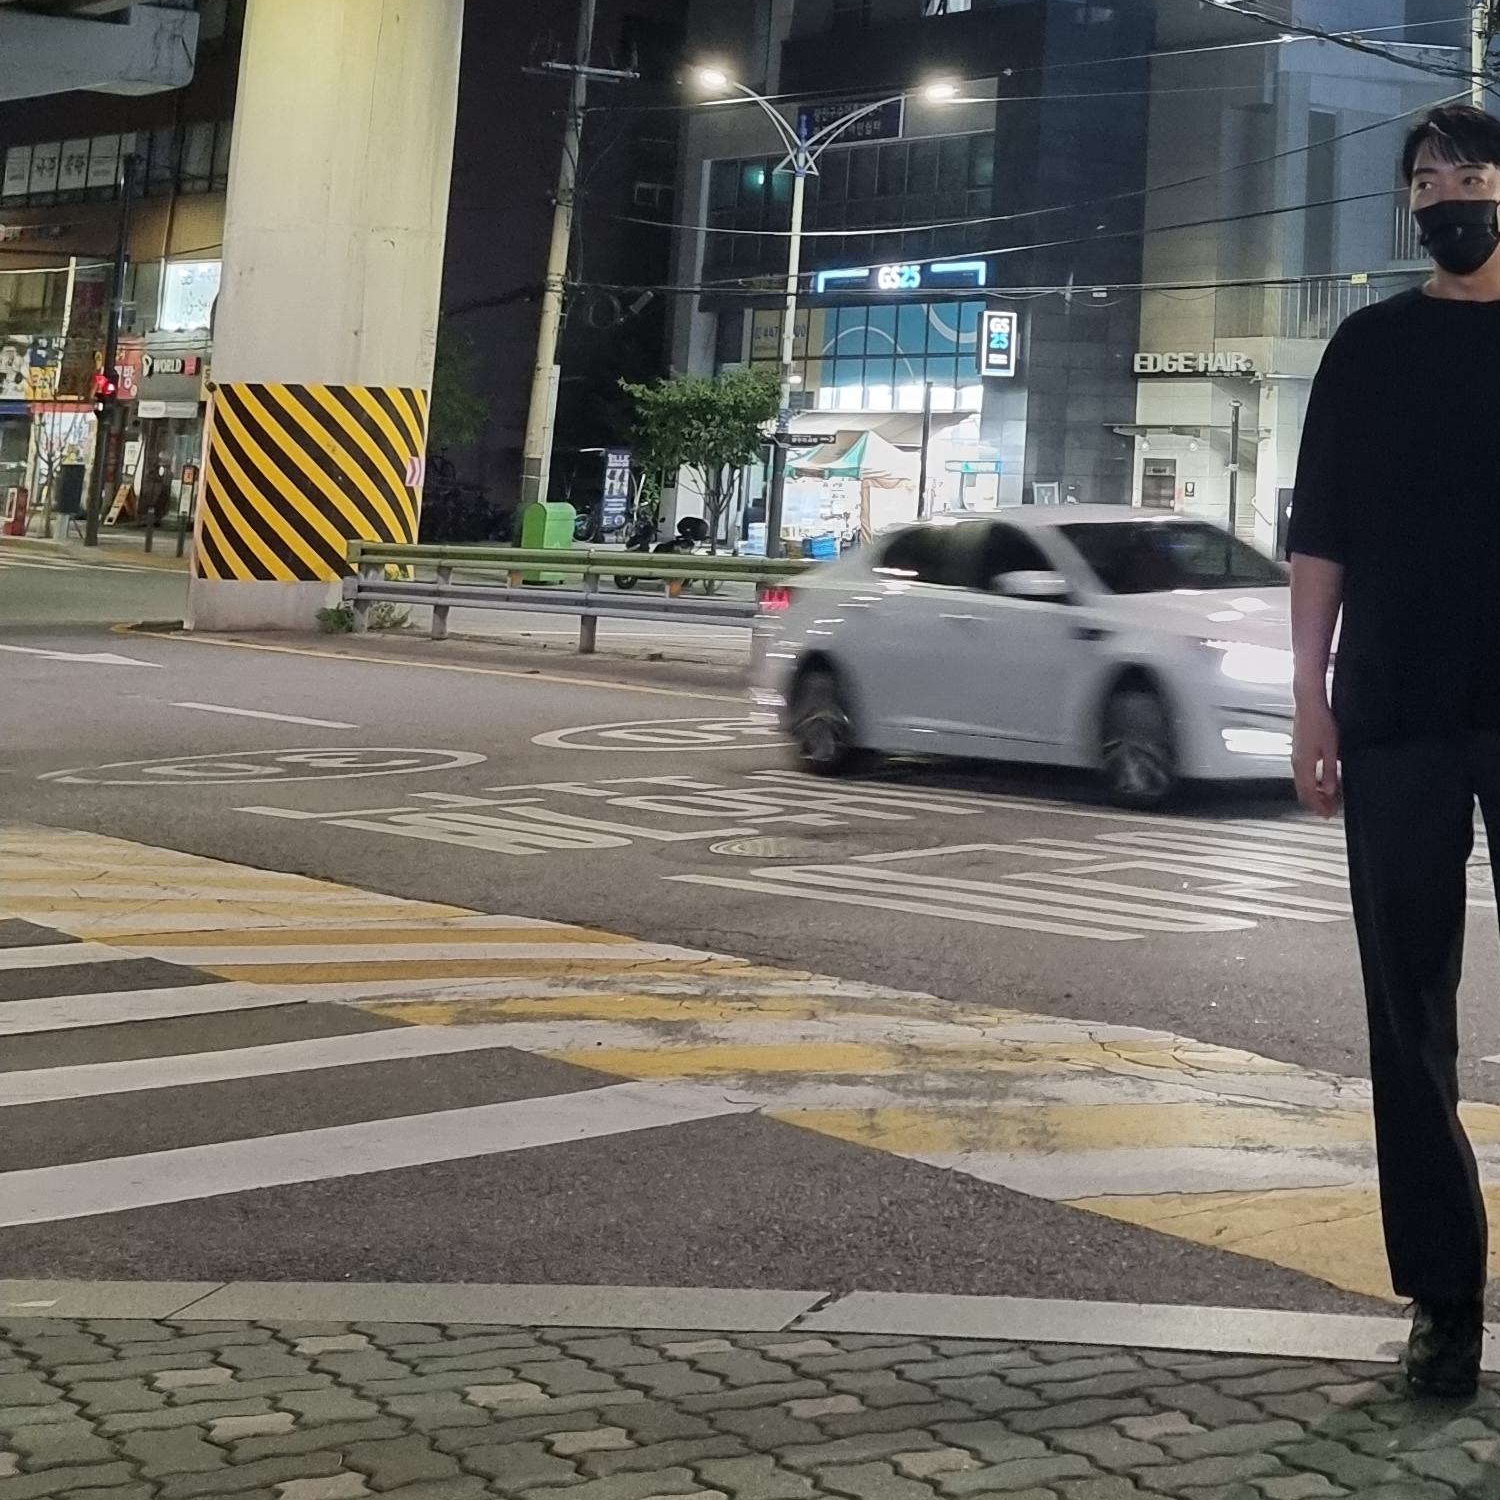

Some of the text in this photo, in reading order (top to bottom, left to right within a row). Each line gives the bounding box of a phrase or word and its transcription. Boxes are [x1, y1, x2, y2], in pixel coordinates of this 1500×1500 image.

[877, 265, 921, 290] GS25
[989, 316, 1010, 333] GS
[989, 332, 1009, 349] 25
[153, 358, 183, 374] WORLD
[1133, 351, 1247, 373] EDGE HAIR
